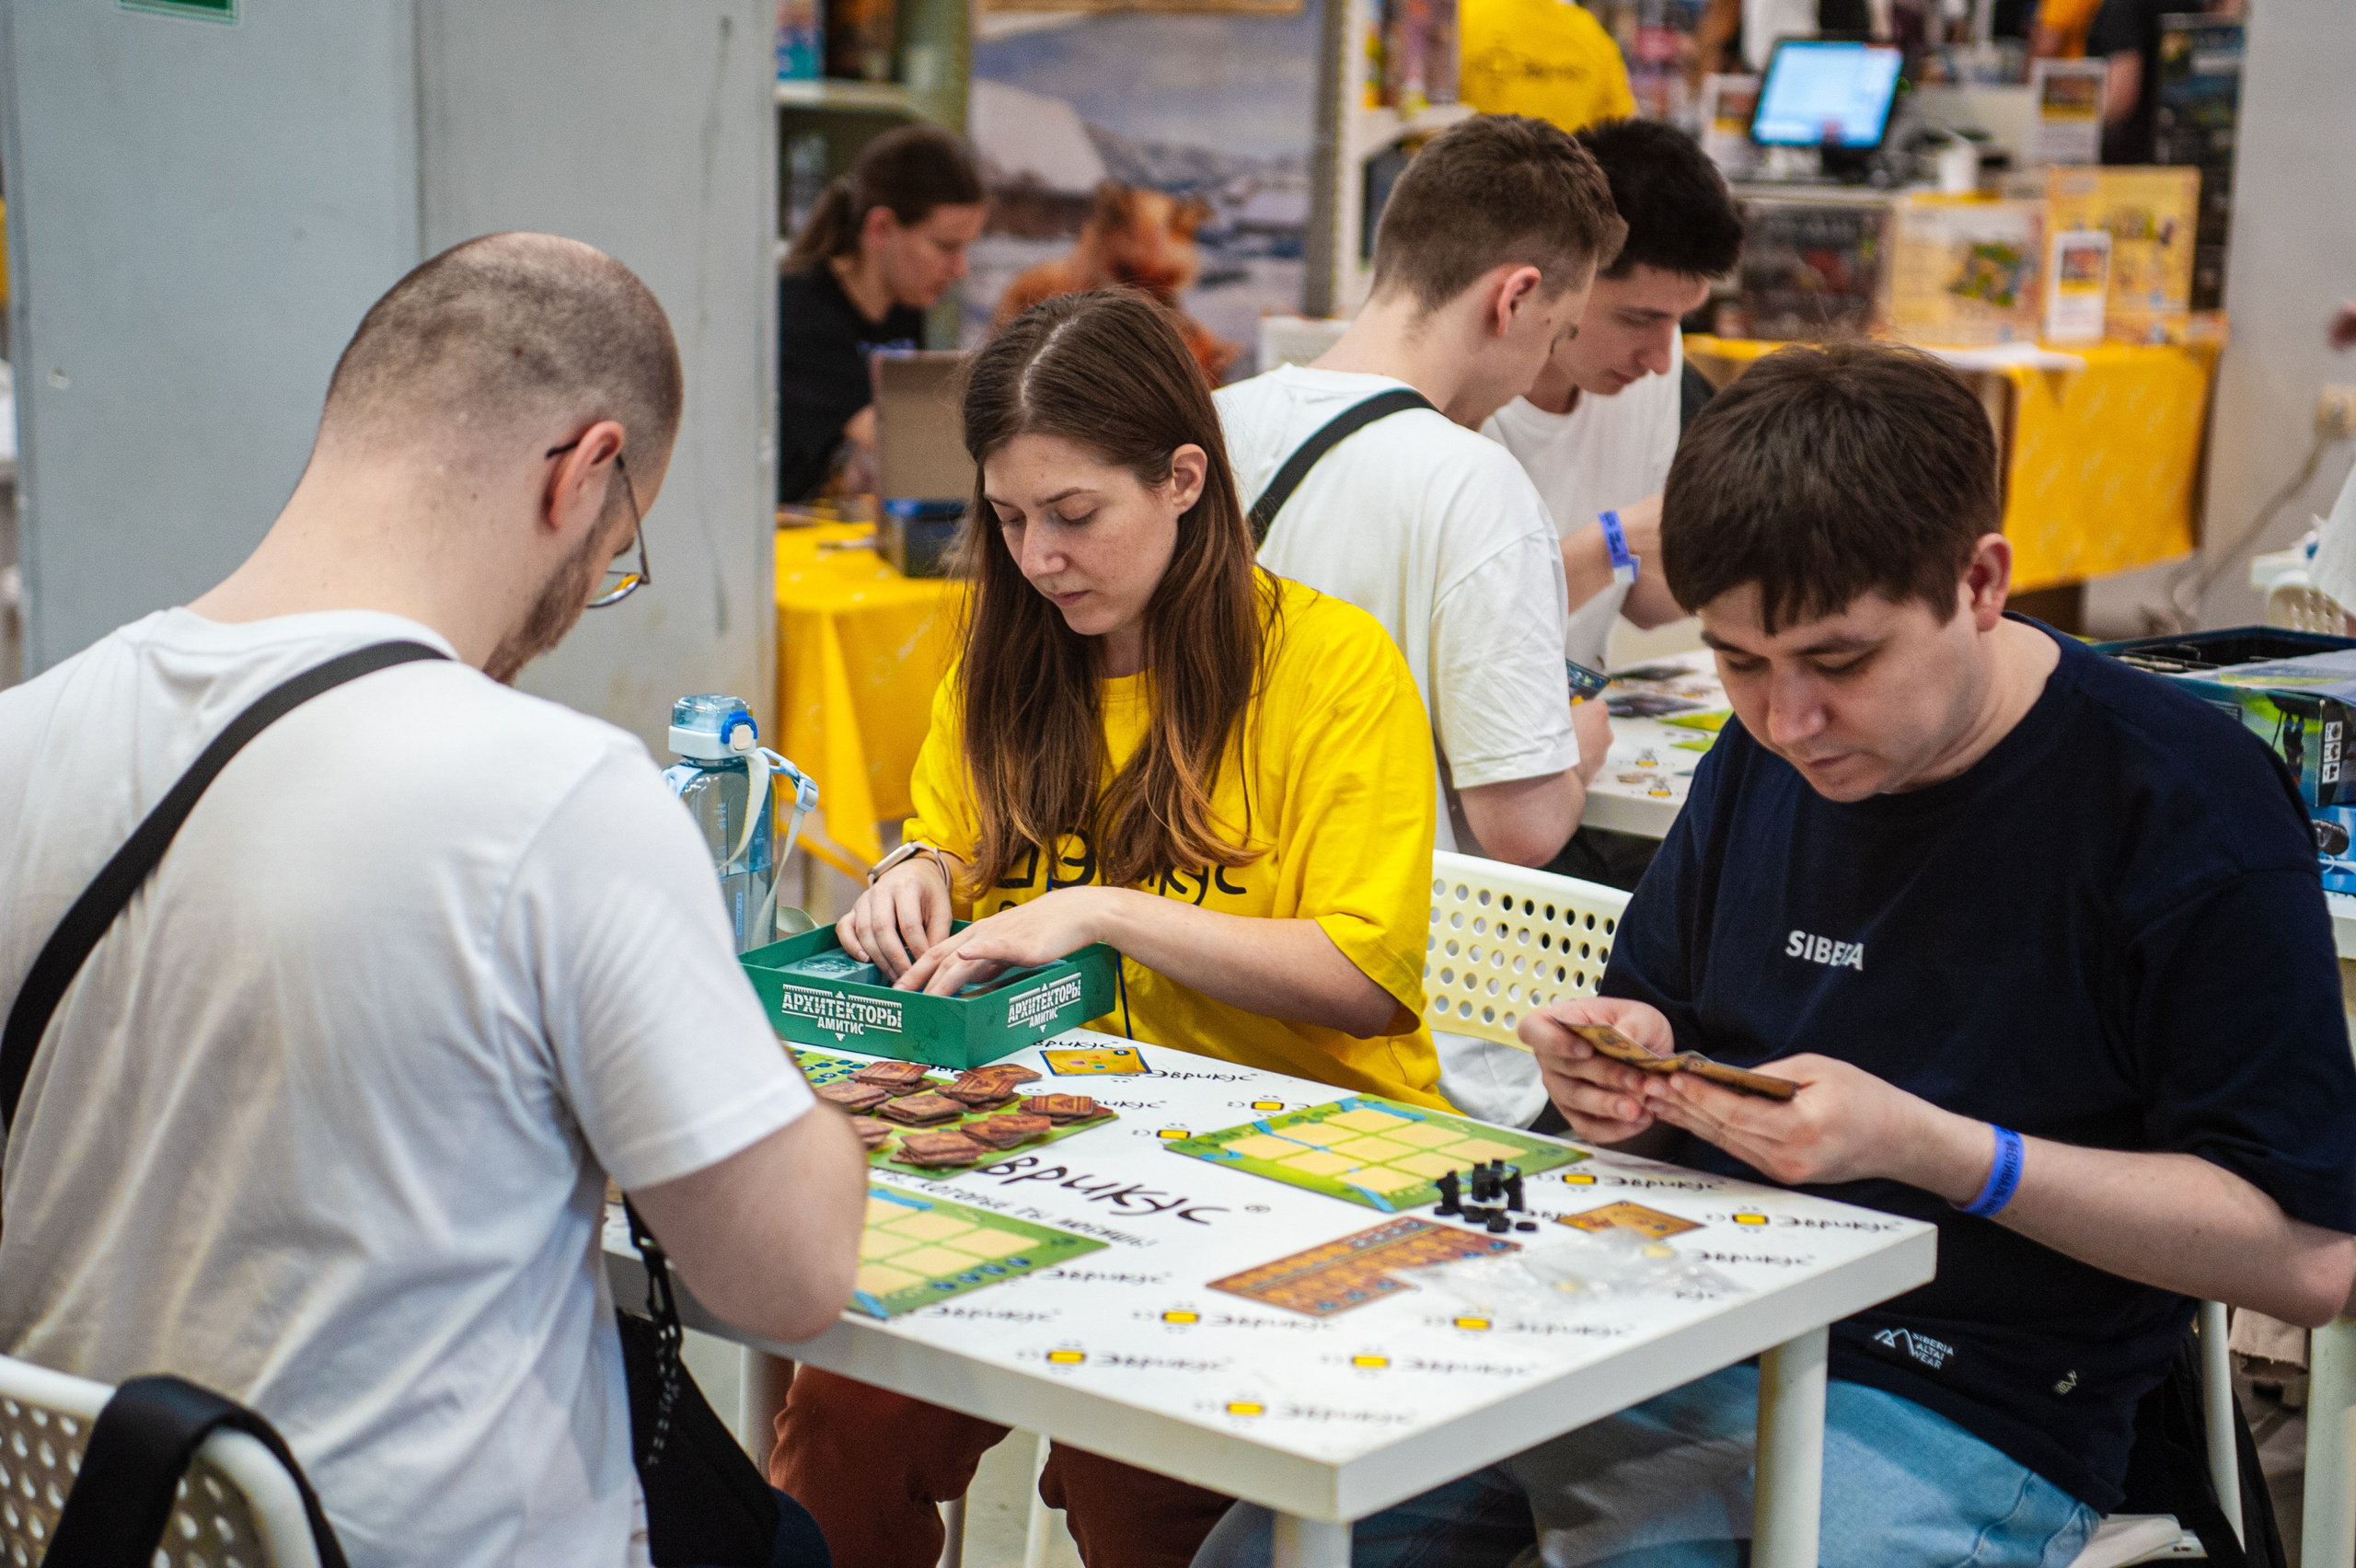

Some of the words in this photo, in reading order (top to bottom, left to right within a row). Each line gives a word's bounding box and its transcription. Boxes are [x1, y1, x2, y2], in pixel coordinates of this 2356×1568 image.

[781, 991, 902, 1028] АРХИТЕКТОРЫ
[1008, 979, 1081, 1023] АРХИТЕКТОРЫ
[817, 1016, 865, 1036] АМИТИС
[1029, 1006, 1058, 1029] АМИТИС
[1032, 1039, 1113, 1049] врикус
[975, 1157, 1230, 1226] врикус
[1604, 1175, 1716, 1193] Эврикус
[1912, 1332, 1954, 1356] SIBERIA
[1916, 1343, 1945, 1361] ALTAI
[1913, 1350, 1942, 1369] WEAR
